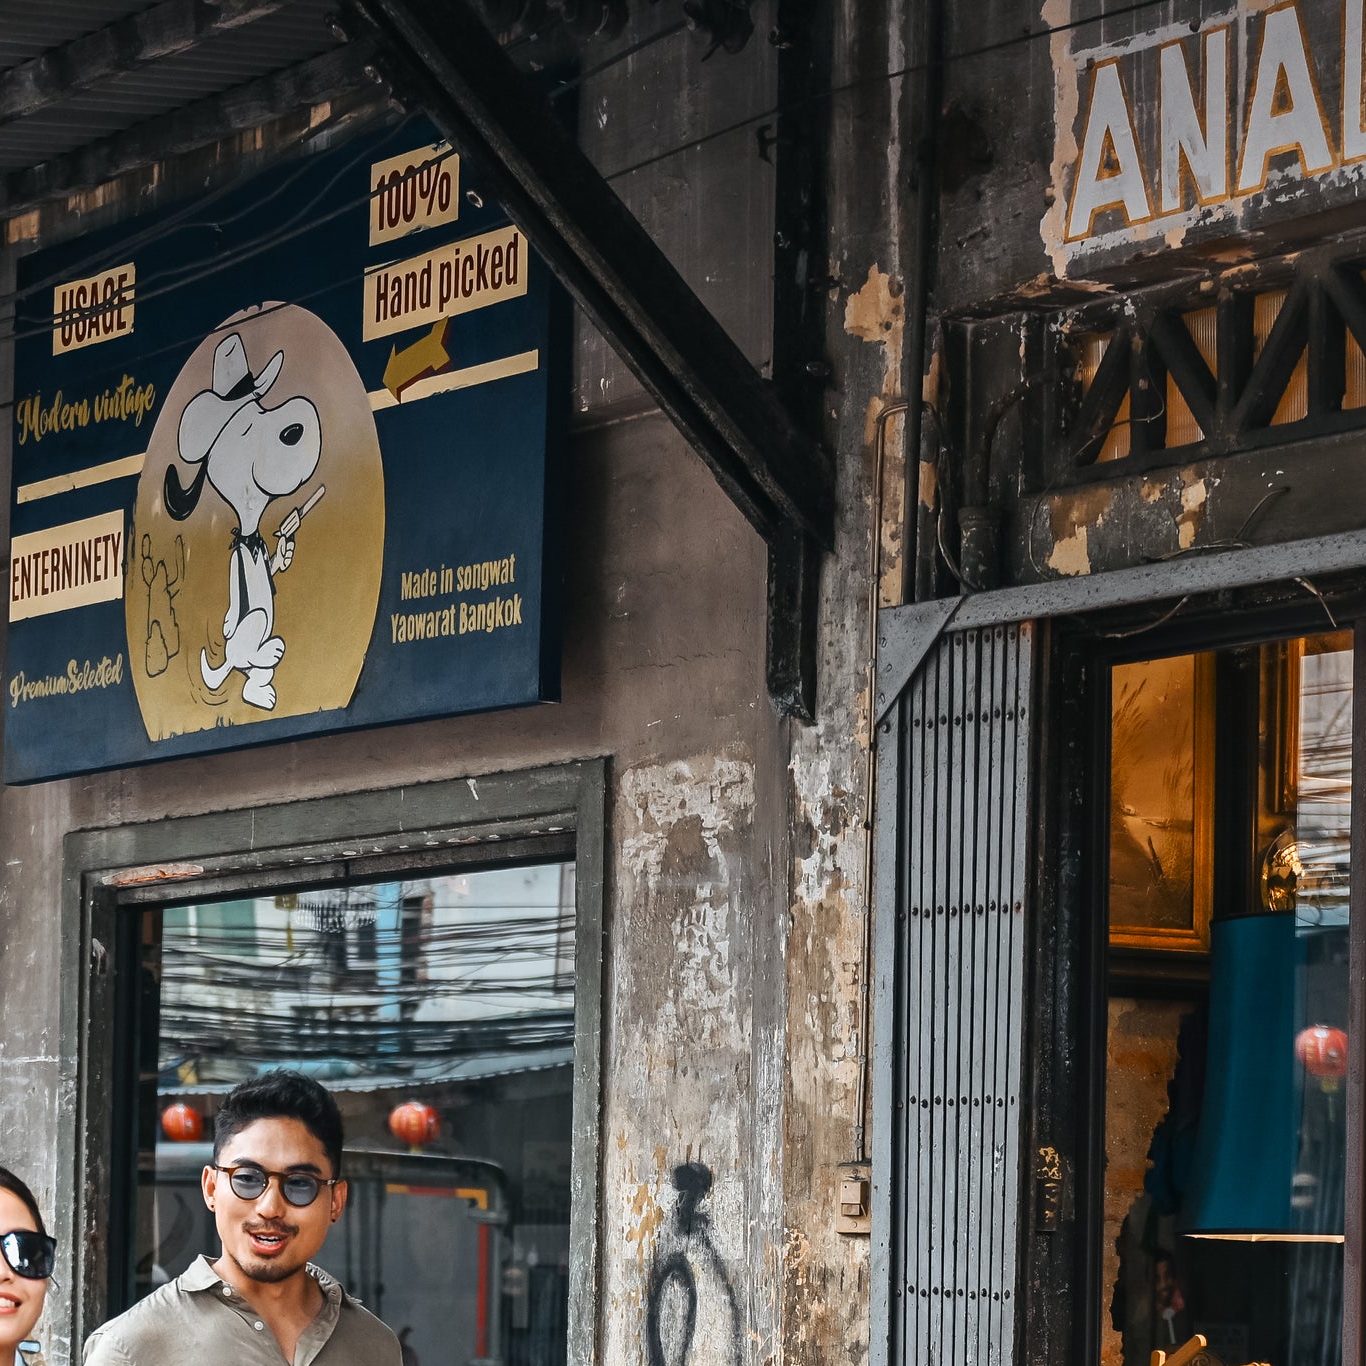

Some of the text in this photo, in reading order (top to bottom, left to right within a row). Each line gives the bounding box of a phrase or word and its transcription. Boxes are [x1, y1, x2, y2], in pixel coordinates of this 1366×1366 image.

[376, 161, 452, 231] 100%
[61, 273, 128, 347] USAGE
[375, 234, 519, 322] Hand picked
[17, 373, 155, 446] Modern vintage
[12, 532, 122, 602] ENTERNINETY
[401, 553, 515, 600] Made in songwat
[390, 594, 522, 646] Yaowarat Bangkok
